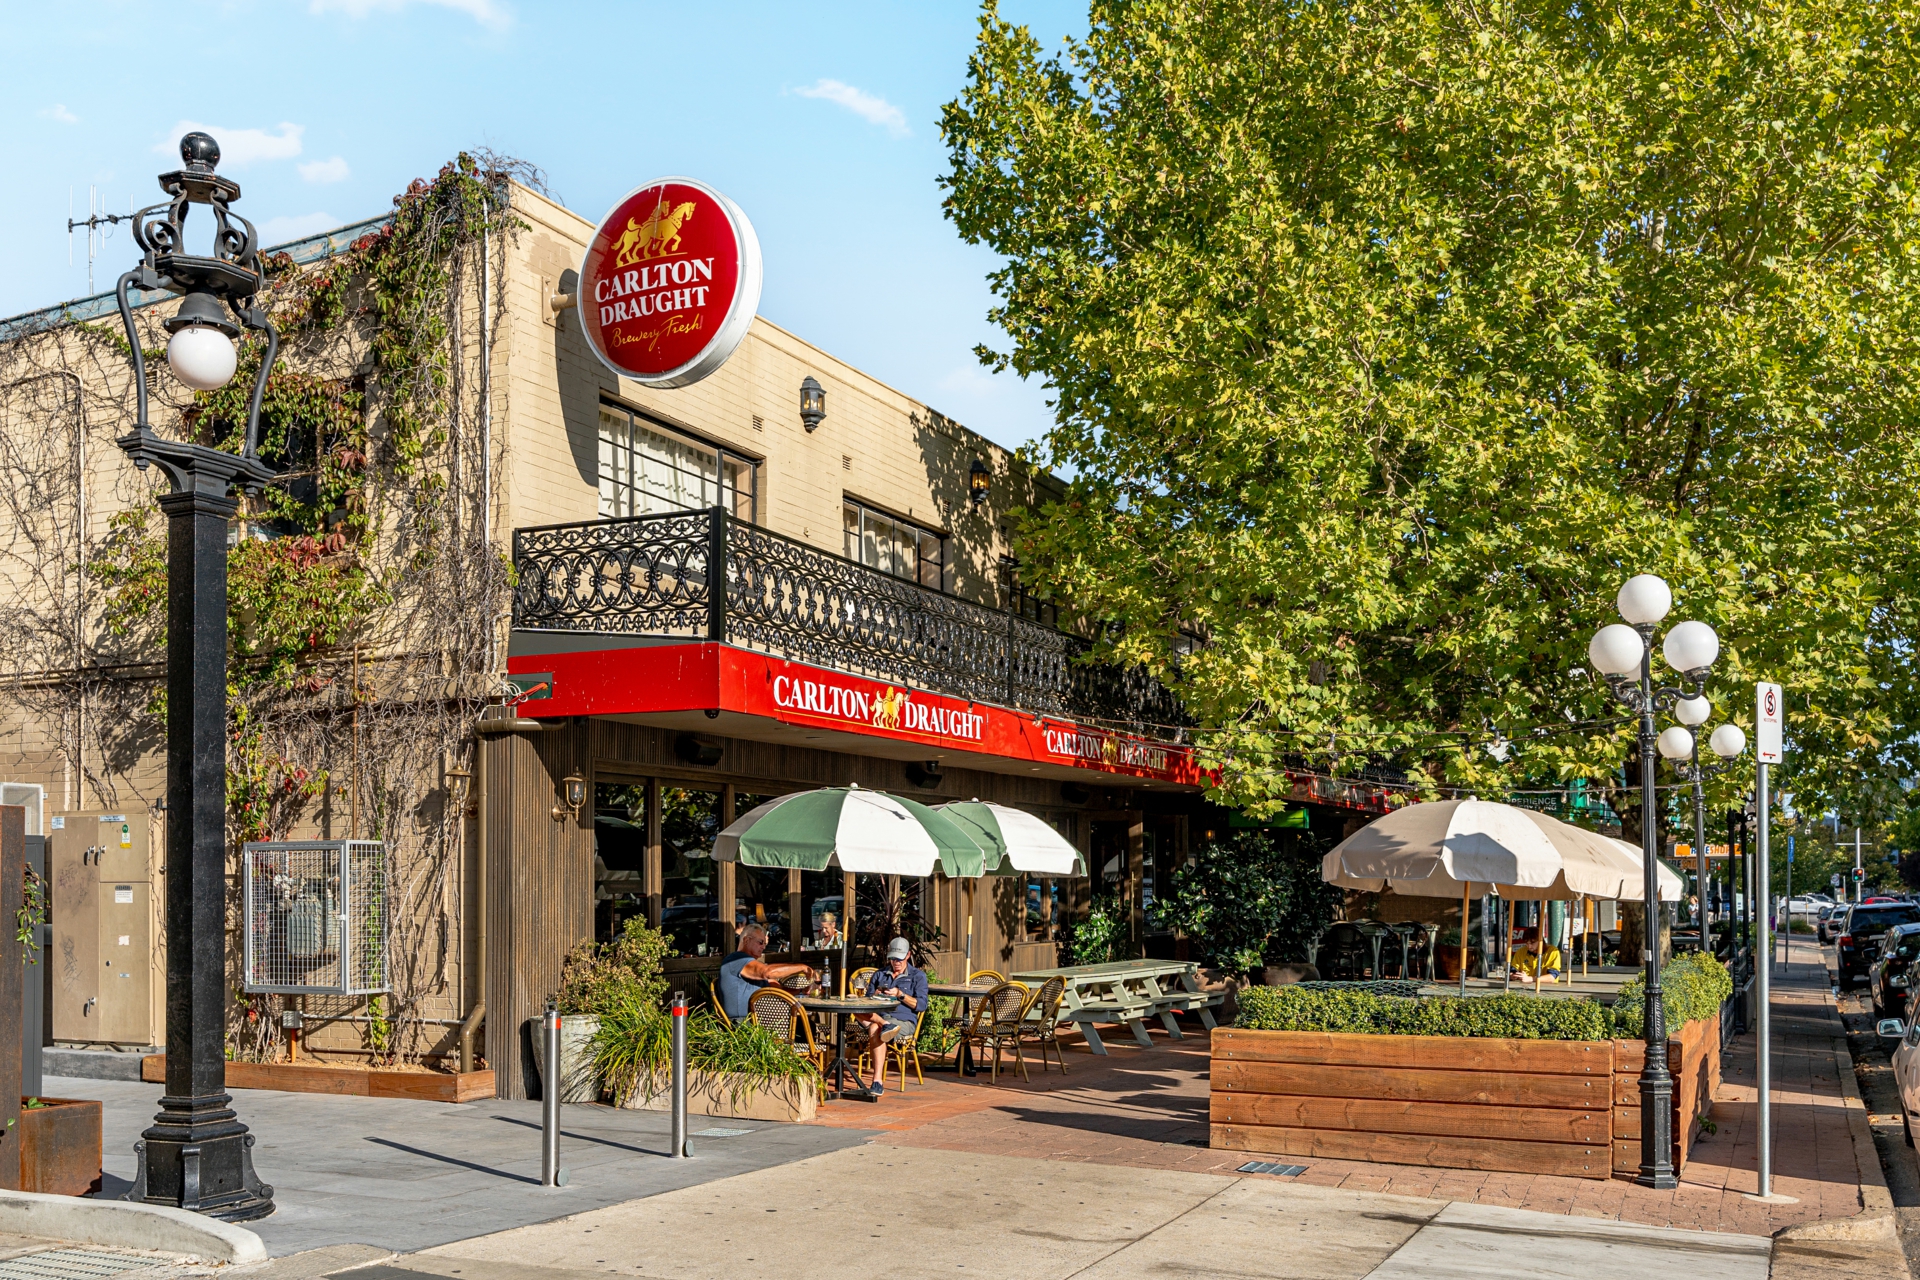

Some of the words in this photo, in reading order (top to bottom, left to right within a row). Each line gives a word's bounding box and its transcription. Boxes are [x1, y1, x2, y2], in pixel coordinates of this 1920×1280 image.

[595, 257, 715, 303] CARLTON
[600, 286, 709, 327] DRAUGHT
[610, 327, 660, 352] Brewery
[661, 313, 701, 337] Fresh
[773, 675, 870, 720] CARLTON
[904, 701, 984, 740] DRAUGHT
[1046, 729, 1101, 759] CARLTON
[1120, 742, 1168, 770] DRAUGHT
